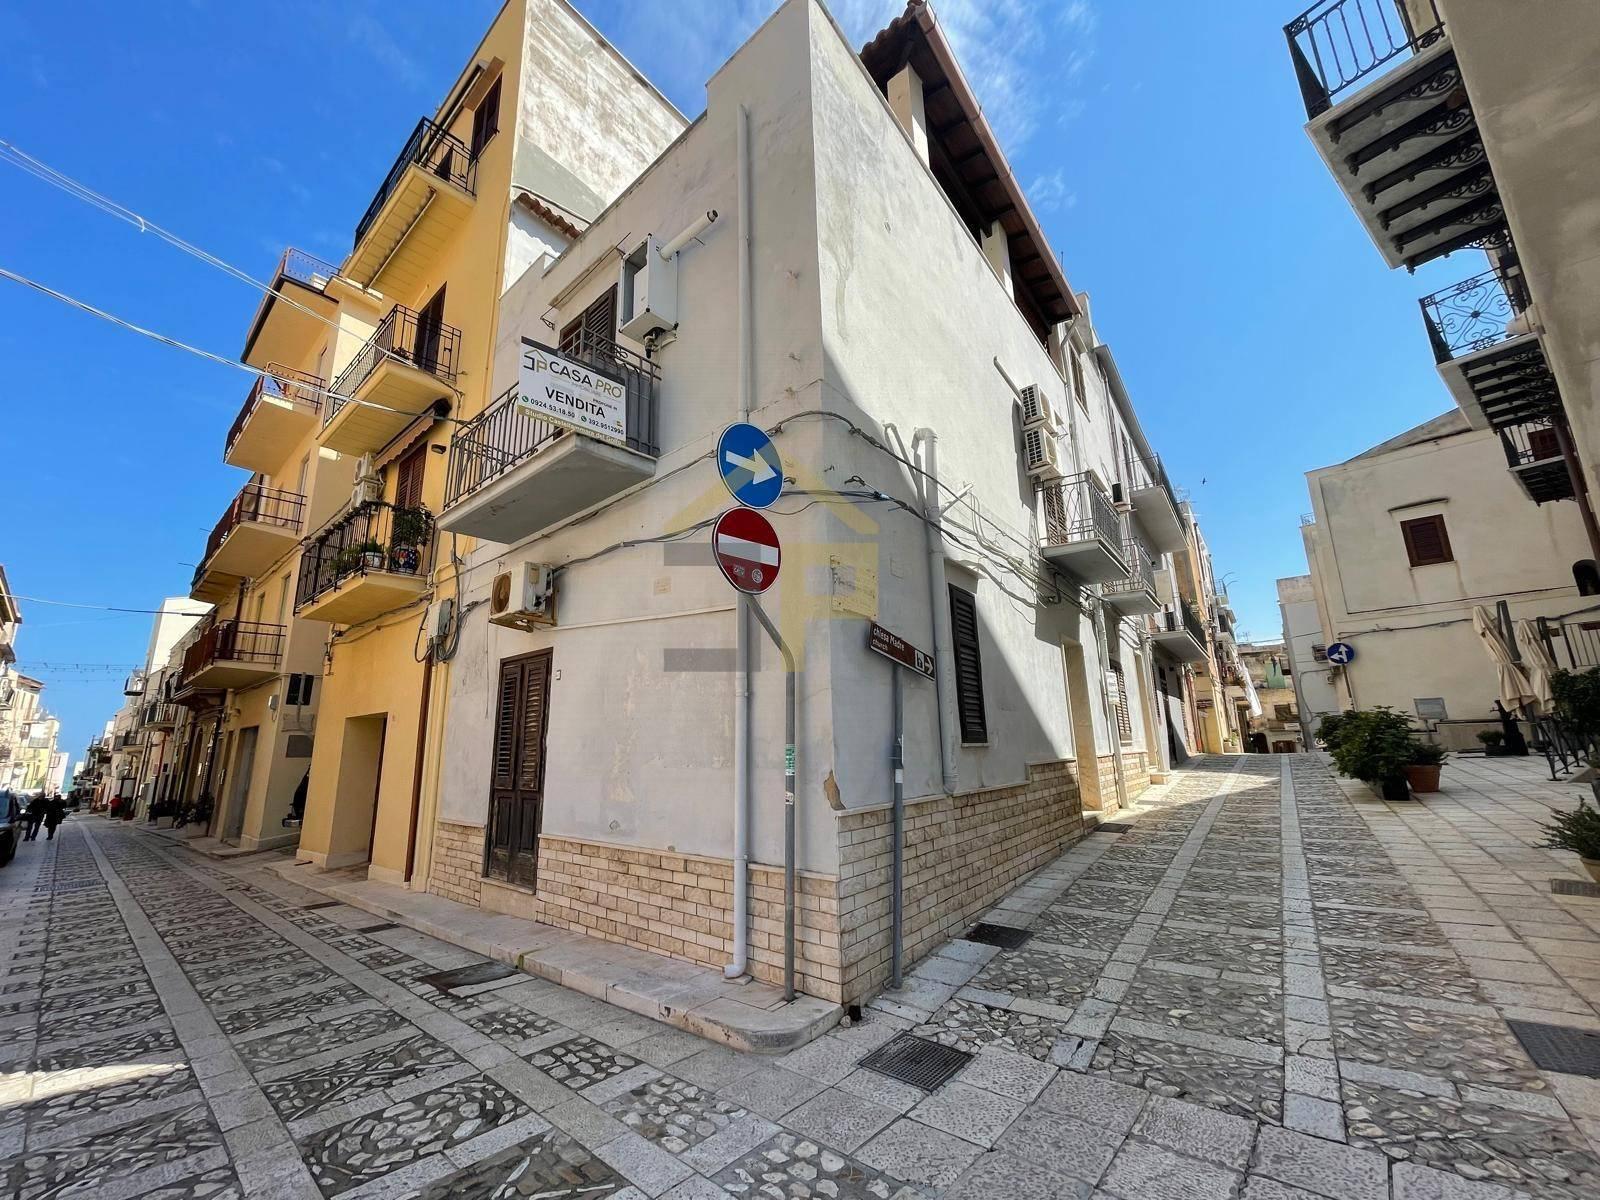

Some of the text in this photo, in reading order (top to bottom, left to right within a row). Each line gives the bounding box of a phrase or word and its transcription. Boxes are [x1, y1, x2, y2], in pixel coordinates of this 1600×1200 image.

[549, 361, 593, 387] CASA
[595, 379, 622, 398] PRO
[545, 386, 605, 418] VENDITA
[525, 408, 548, 421] Studio
[889, 635, 905, 651] Madre
